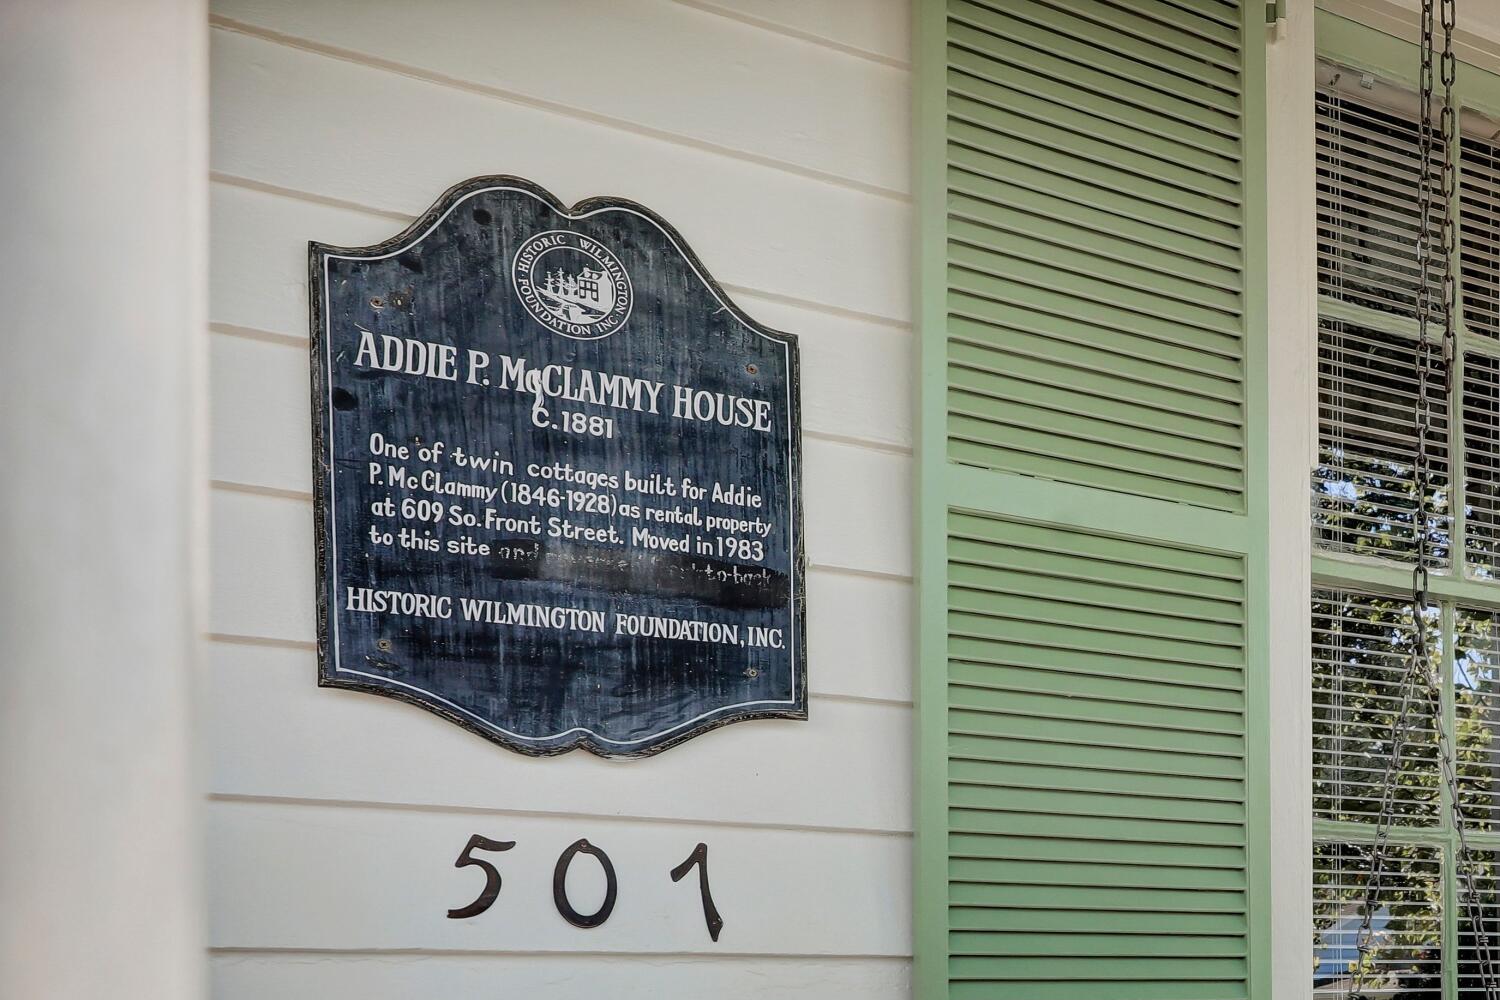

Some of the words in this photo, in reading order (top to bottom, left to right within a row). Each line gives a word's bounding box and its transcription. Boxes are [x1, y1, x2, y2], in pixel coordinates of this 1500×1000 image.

[518, 234, 566, 274] HISTORIC
[579, 238, 629, 316] WILMINGTON
[518, 278, 592, 335] FOUNDATION
[353, 330, 458, 382] ADDIE
[466, 349, 490, 386] P.
[672, 384, 773, 433] HOUSE
[369, 432, 410, 460] One
[417, 441, 445, 464] of
[451, 446, 514, 476] twin
[526, 461, 619, 490] cottages
[624, 470, 677, 497] built
[680, 477, 708, 500] for
[711, 481, 762, 508] Addie
[369, 462, 384, 486] P.
[388, 464, 499, 504] McClammy
[501, 480, 617, 517] (1846-1928)
[618, 502, 641, 519] as
[645, 506, 703, 527] rental
[705, 514, 773, 538] property
[368, 524, 394, 546] to
[397, 527, 440, 552] this
[446, 534, 491, 556] site
[371, 496, 396, 518] at
[401, 497, 444, 523] 609
[448, 504, 482, 528] So.
[484, 507, 542, 536] Front
[547, 516, 625, 546] Street.
[631, 526, 691, 554] Moved
[696, 535, 714, 556] in
[715, 536, 764, 562] 1983
[345, 586, 452, 620] HISTORIC
[459, 597, 606, 633] WILMINGTON
[614, 612, 746, 649] FOUNDATION,
[746, 625, 786, 650] INC.
[446, 833, 724, 943] 501
